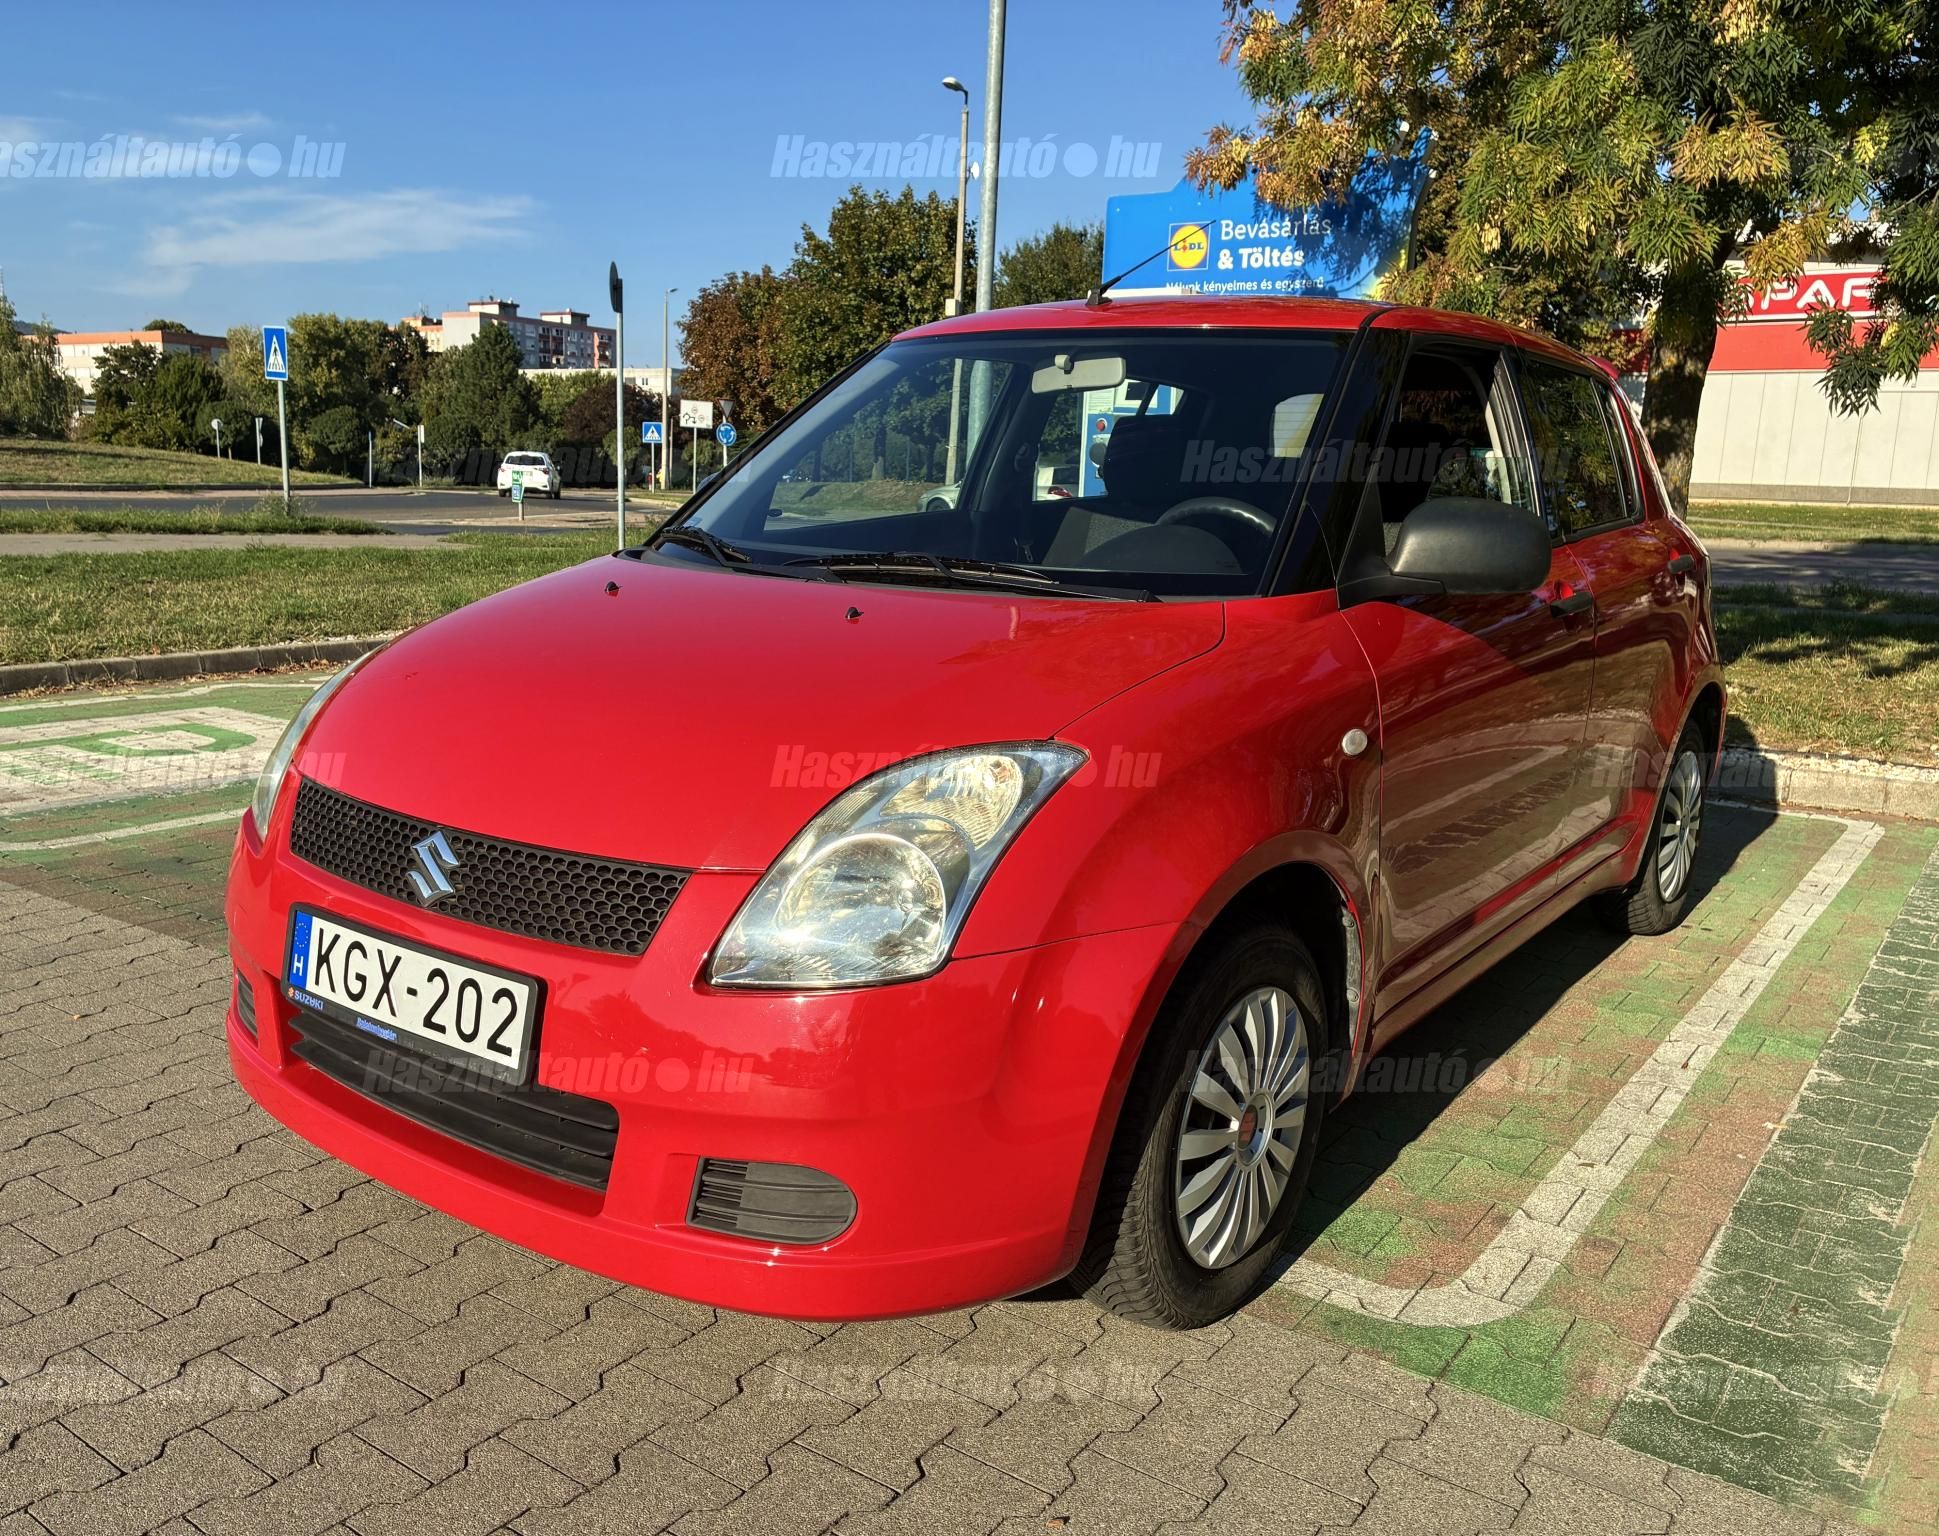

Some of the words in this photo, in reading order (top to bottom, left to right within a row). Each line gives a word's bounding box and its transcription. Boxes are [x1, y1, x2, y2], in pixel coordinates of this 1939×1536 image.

[1221, 216, 1332, 241] Bevásárlás
[1217, 250, 1234, 270] &
[1239, 246, 1305, 269] Töltés
[1203, 279, 1258, 295] kényelmes
[1260, 278, 1272, 290] és
[292, 953, 304, 976] H
[314, 926, 518, 1057] KGX-202
